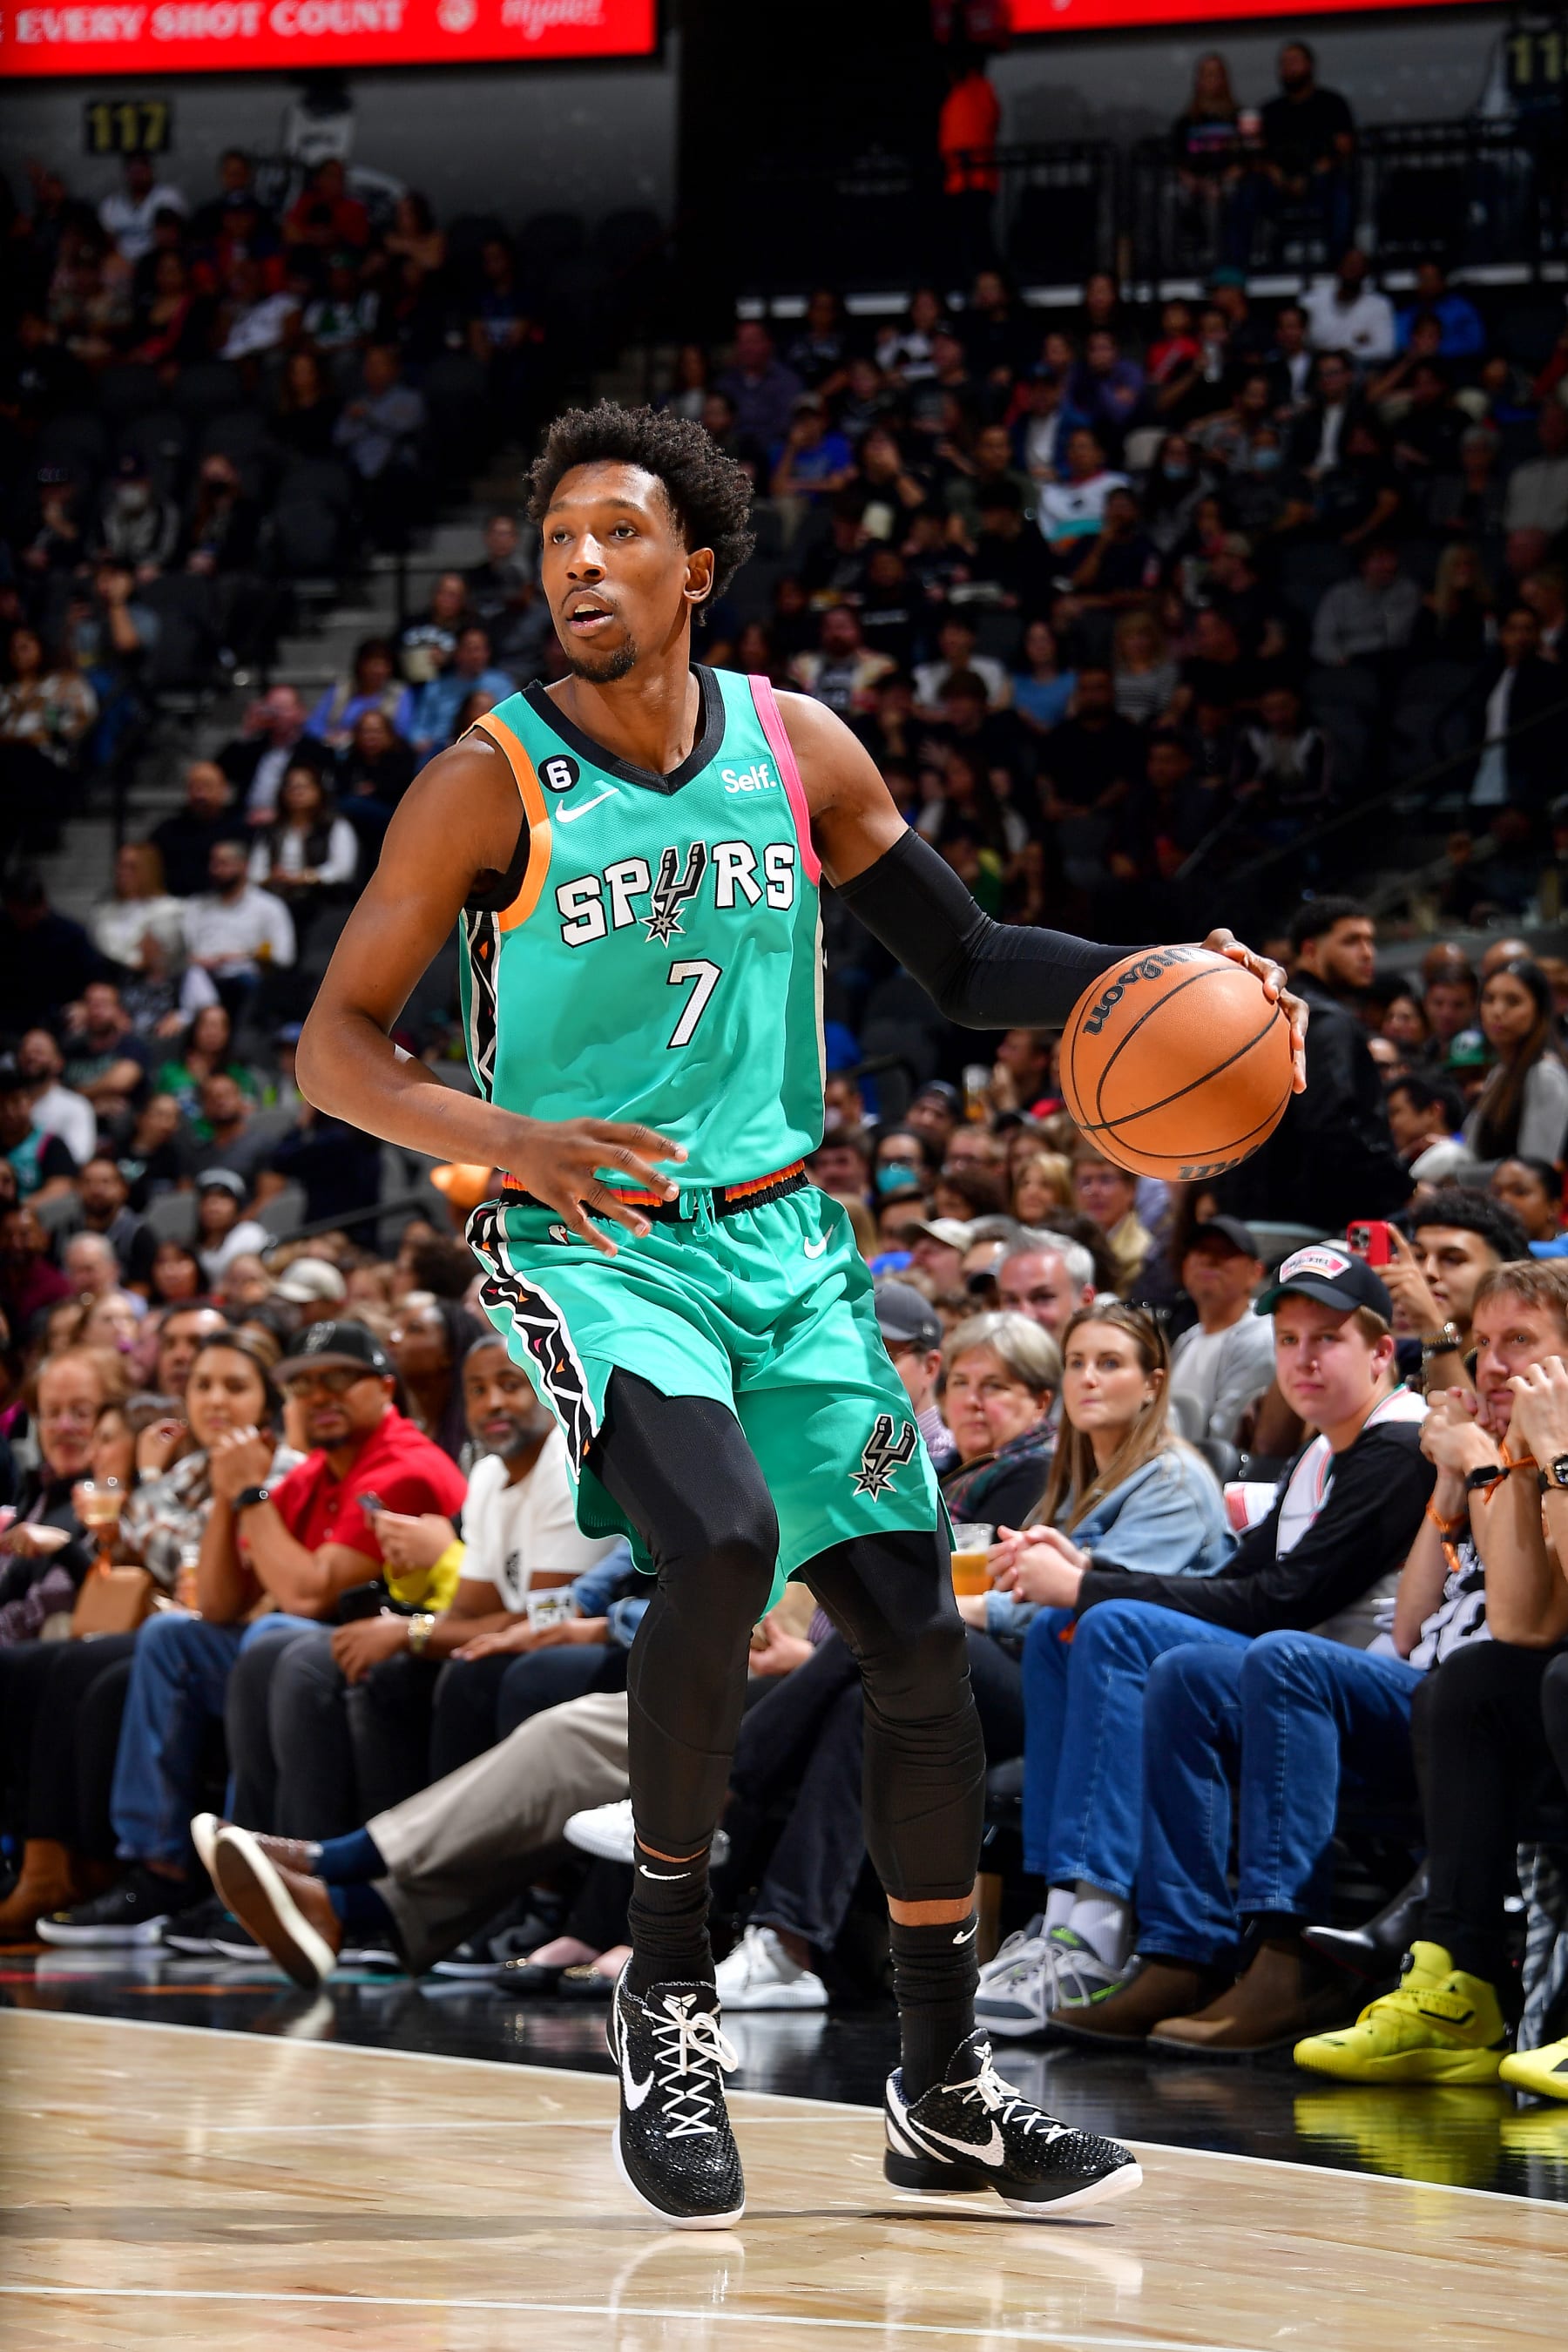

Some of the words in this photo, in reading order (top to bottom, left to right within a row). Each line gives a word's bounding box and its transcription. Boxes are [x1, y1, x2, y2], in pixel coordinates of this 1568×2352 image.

[16, 5, 146, 43] EVERY
[151, 3, 263, 40] SHOT
[269, 0, 404, 36] COUNT
[1506, 31, 1568, 84] 11
[90, 102, 166, 152] 117
[546, 760, 572, 789] 6
[721, 763, 777, 794] Self.
[555, 840, 795, 948] SPURS
[666, 959, 722, 1050] 7
